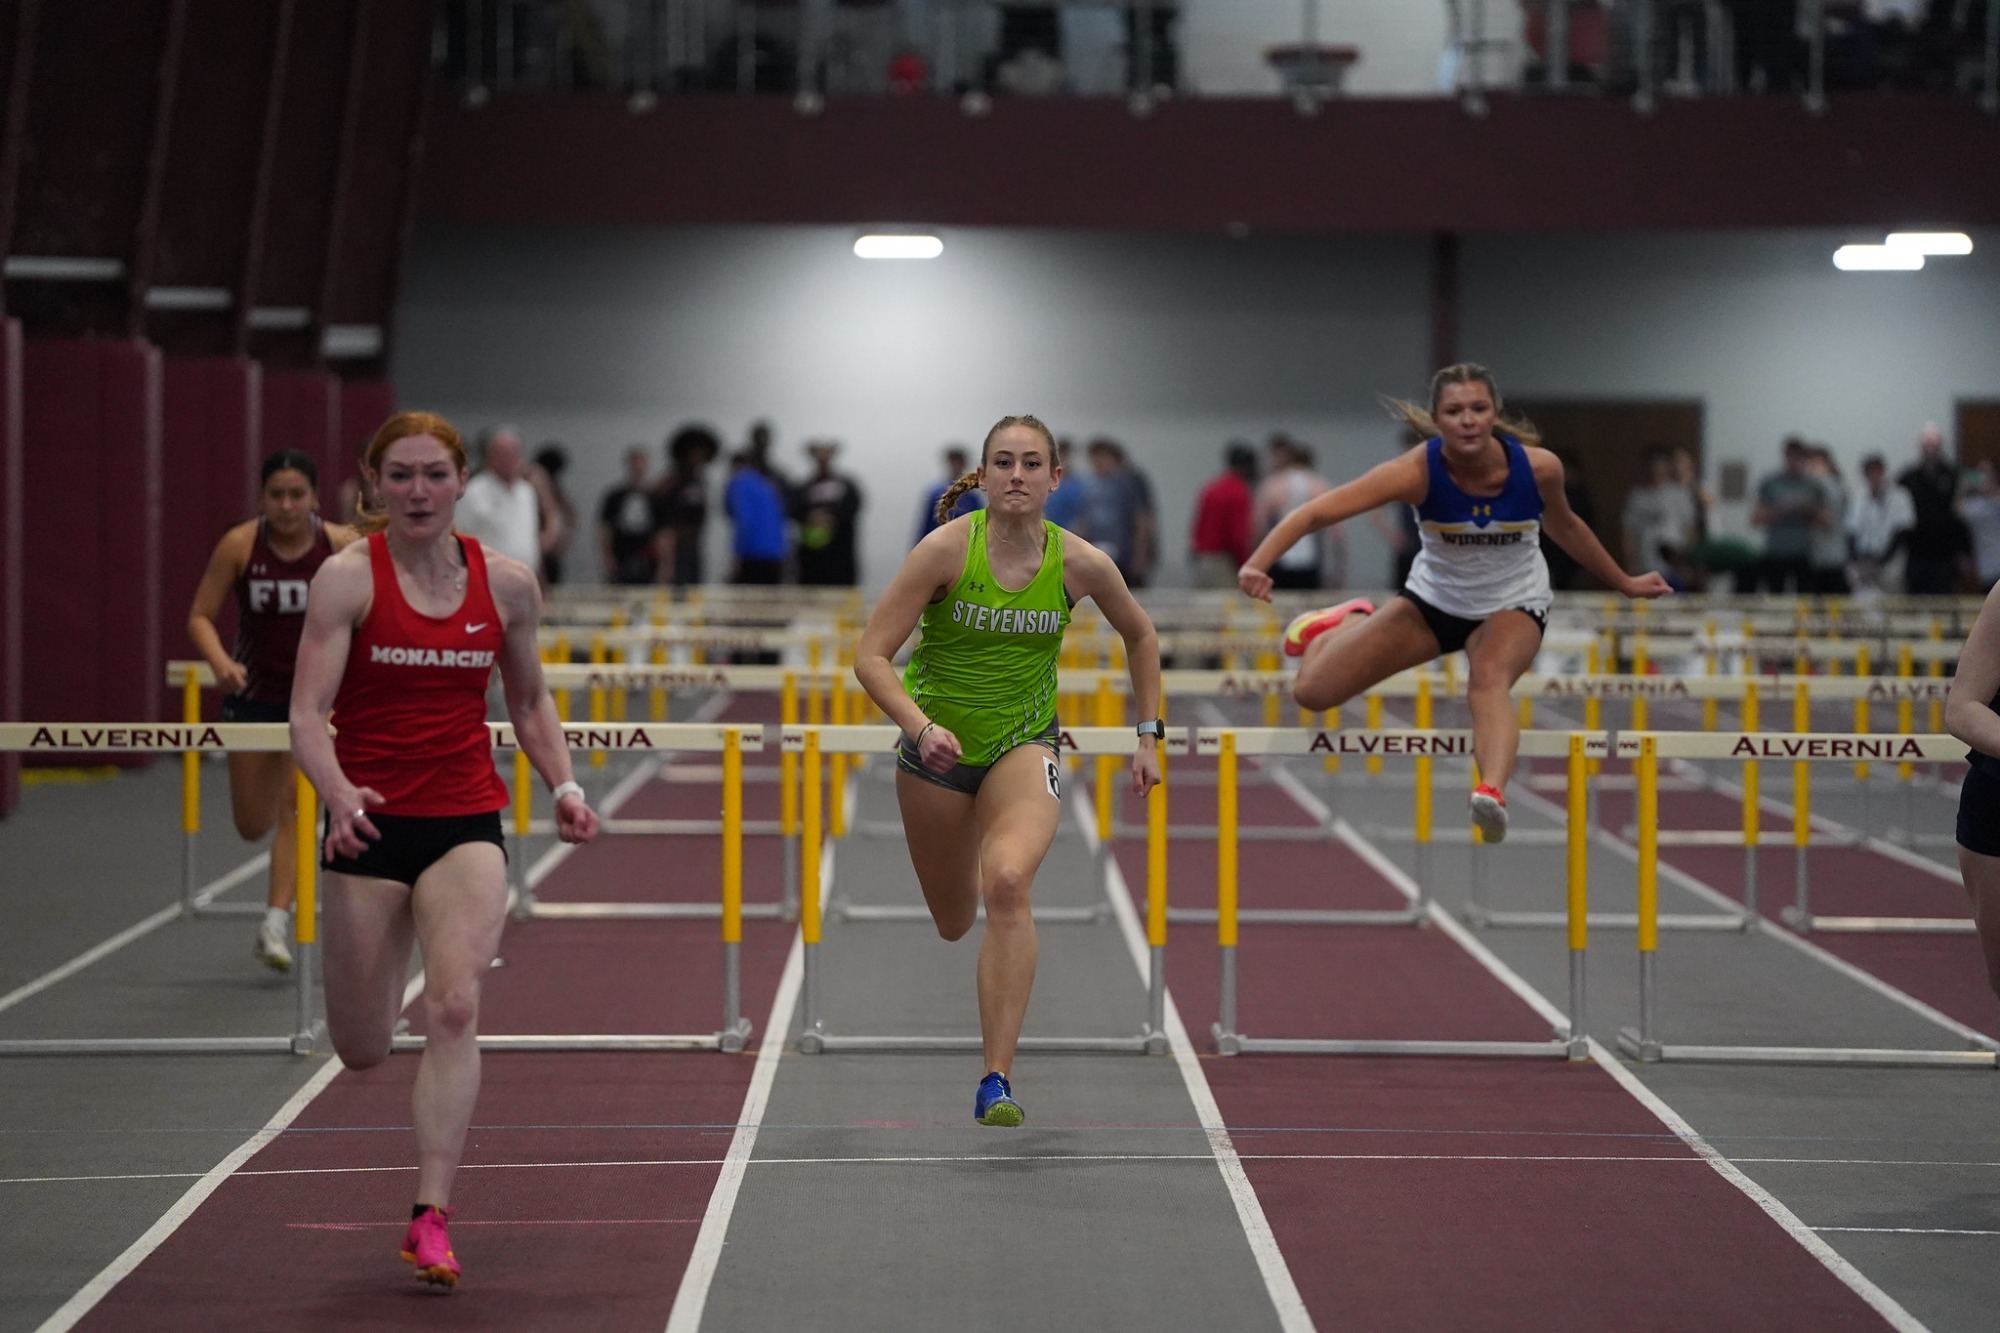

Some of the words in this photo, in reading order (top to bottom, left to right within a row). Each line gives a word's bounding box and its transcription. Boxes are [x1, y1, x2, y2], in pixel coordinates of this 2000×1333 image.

[1441, 531, 1522, 545] WIDENER
[249, 579, 308, 613] FD
[952, 600, 1061, 634] STEVENSON
[371, 645, 495, 668] MONARCHS
[1543, 678, 1688, 695] ALVERNIA
[1868, 679, 1952, 696] ALVE
[29, 727, 225, 748] ALVERNIA
[496, 728, 652, 748] LRNIA
[1309, 732, 1475, 753] ALVERNI
[1731, 736, 1925, 758] ALVERNIA
